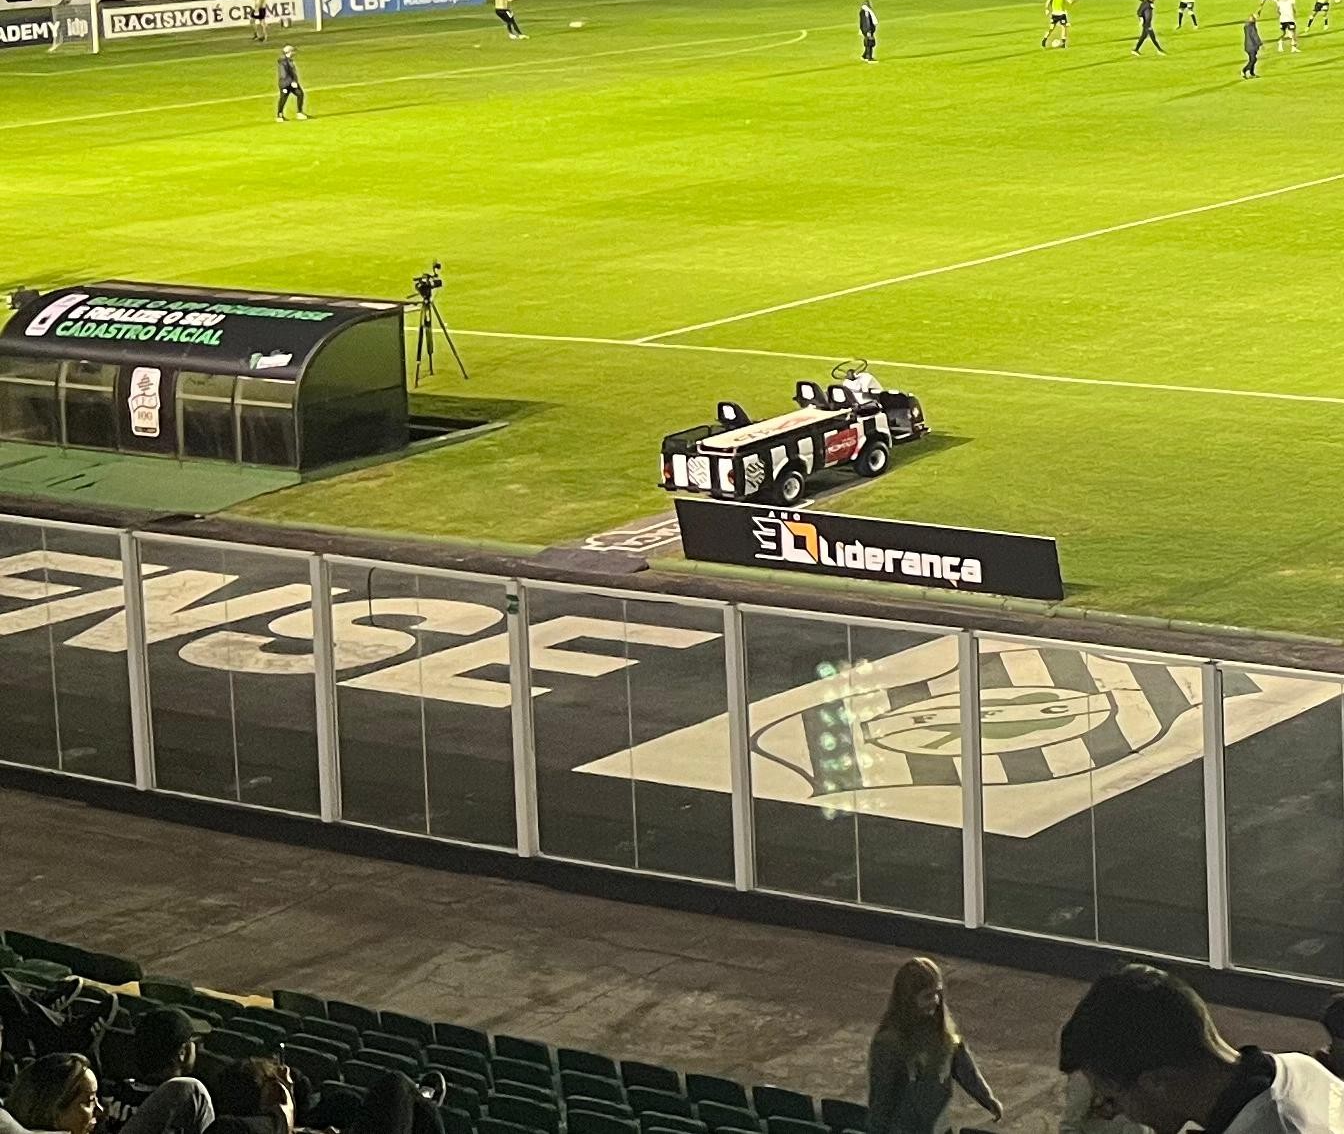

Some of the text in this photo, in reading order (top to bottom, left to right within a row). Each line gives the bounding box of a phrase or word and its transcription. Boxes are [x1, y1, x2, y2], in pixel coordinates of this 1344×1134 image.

[112, 2, 297, 33] RACISMO É CRME!
[67, 305, 227, 327] E REALIZE O SEU
[55, 321, 224, 347] CADASTRO FACIAL
[818, 534, 982, 588] Liderança
